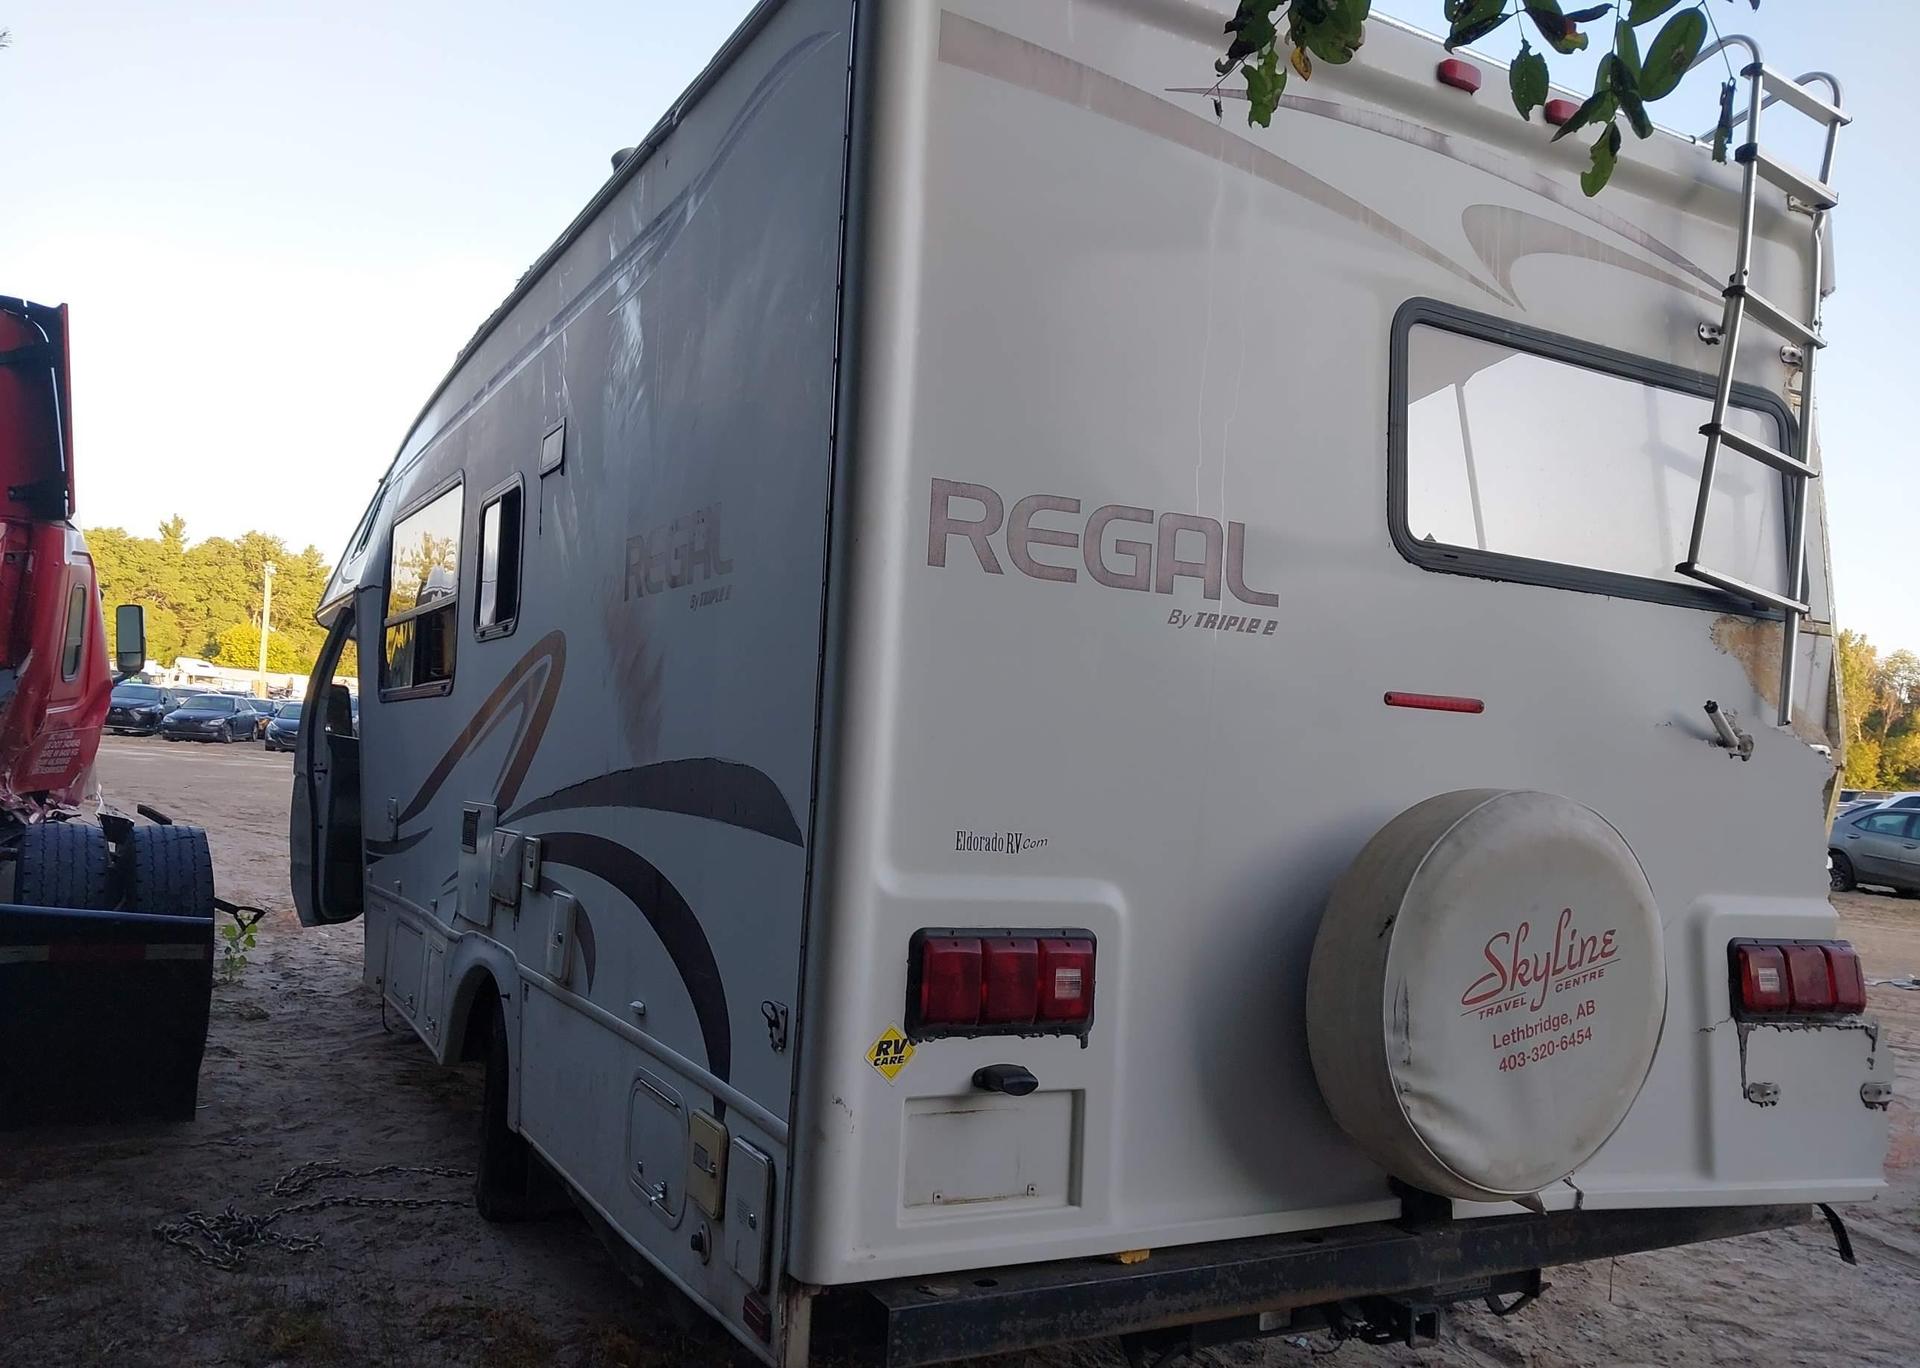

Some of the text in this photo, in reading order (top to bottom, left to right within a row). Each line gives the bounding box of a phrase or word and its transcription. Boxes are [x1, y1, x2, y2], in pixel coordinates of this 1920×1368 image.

[624, 502, 735, 602] REGAL
[927, 477, 1280, 608] REGAL
[1167, 608, 1193, 629] By
[955, 830, 1004, 852] Eldorado
[1478, 968, 1605, 1021] TRAVEL CENTRE
[875, 1038, 908, 1057] RV
[1492, 999, 1596, 1050] Lethbridge, AB
[873, 1055, 905, 1067] CARE
[1498, 1026, 1593, 1073] 403-320-6454
